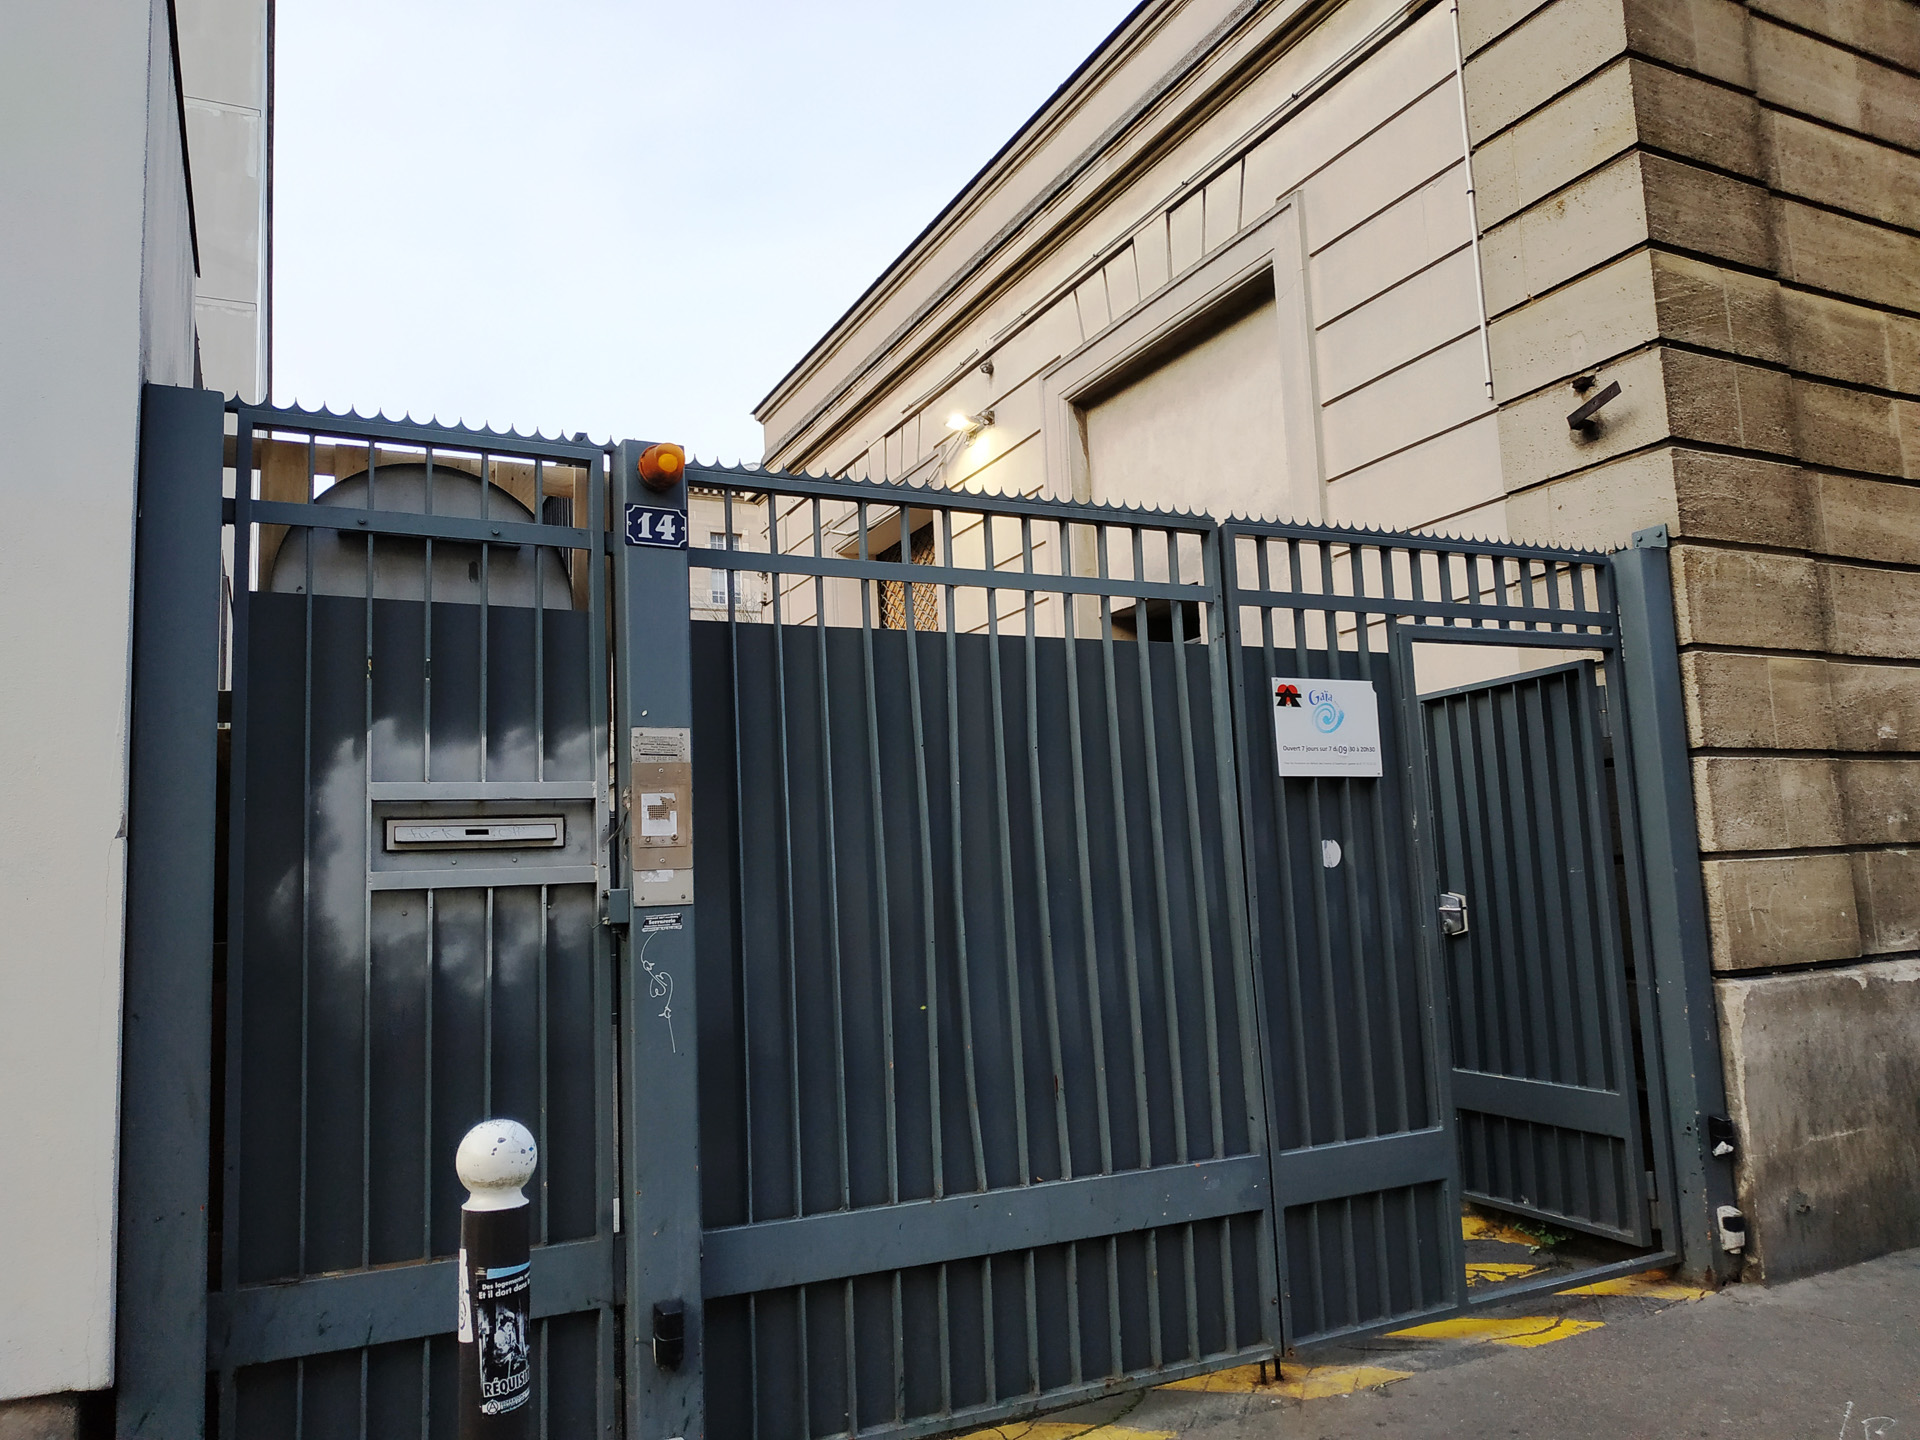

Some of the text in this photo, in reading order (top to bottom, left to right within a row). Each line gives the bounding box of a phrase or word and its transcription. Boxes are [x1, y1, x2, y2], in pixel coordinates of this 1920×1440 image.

[637, 512, 676, 541] 14
[478, 1291, 486, 1300] Et
[487, 1290, 493, 1299] il
[495, 1287, 512, 1298] dort
[513, 1282, 528, 1293] dans
[481, 1283, 494, 1291] Des
[495, 1275, 524, 1289] logements
